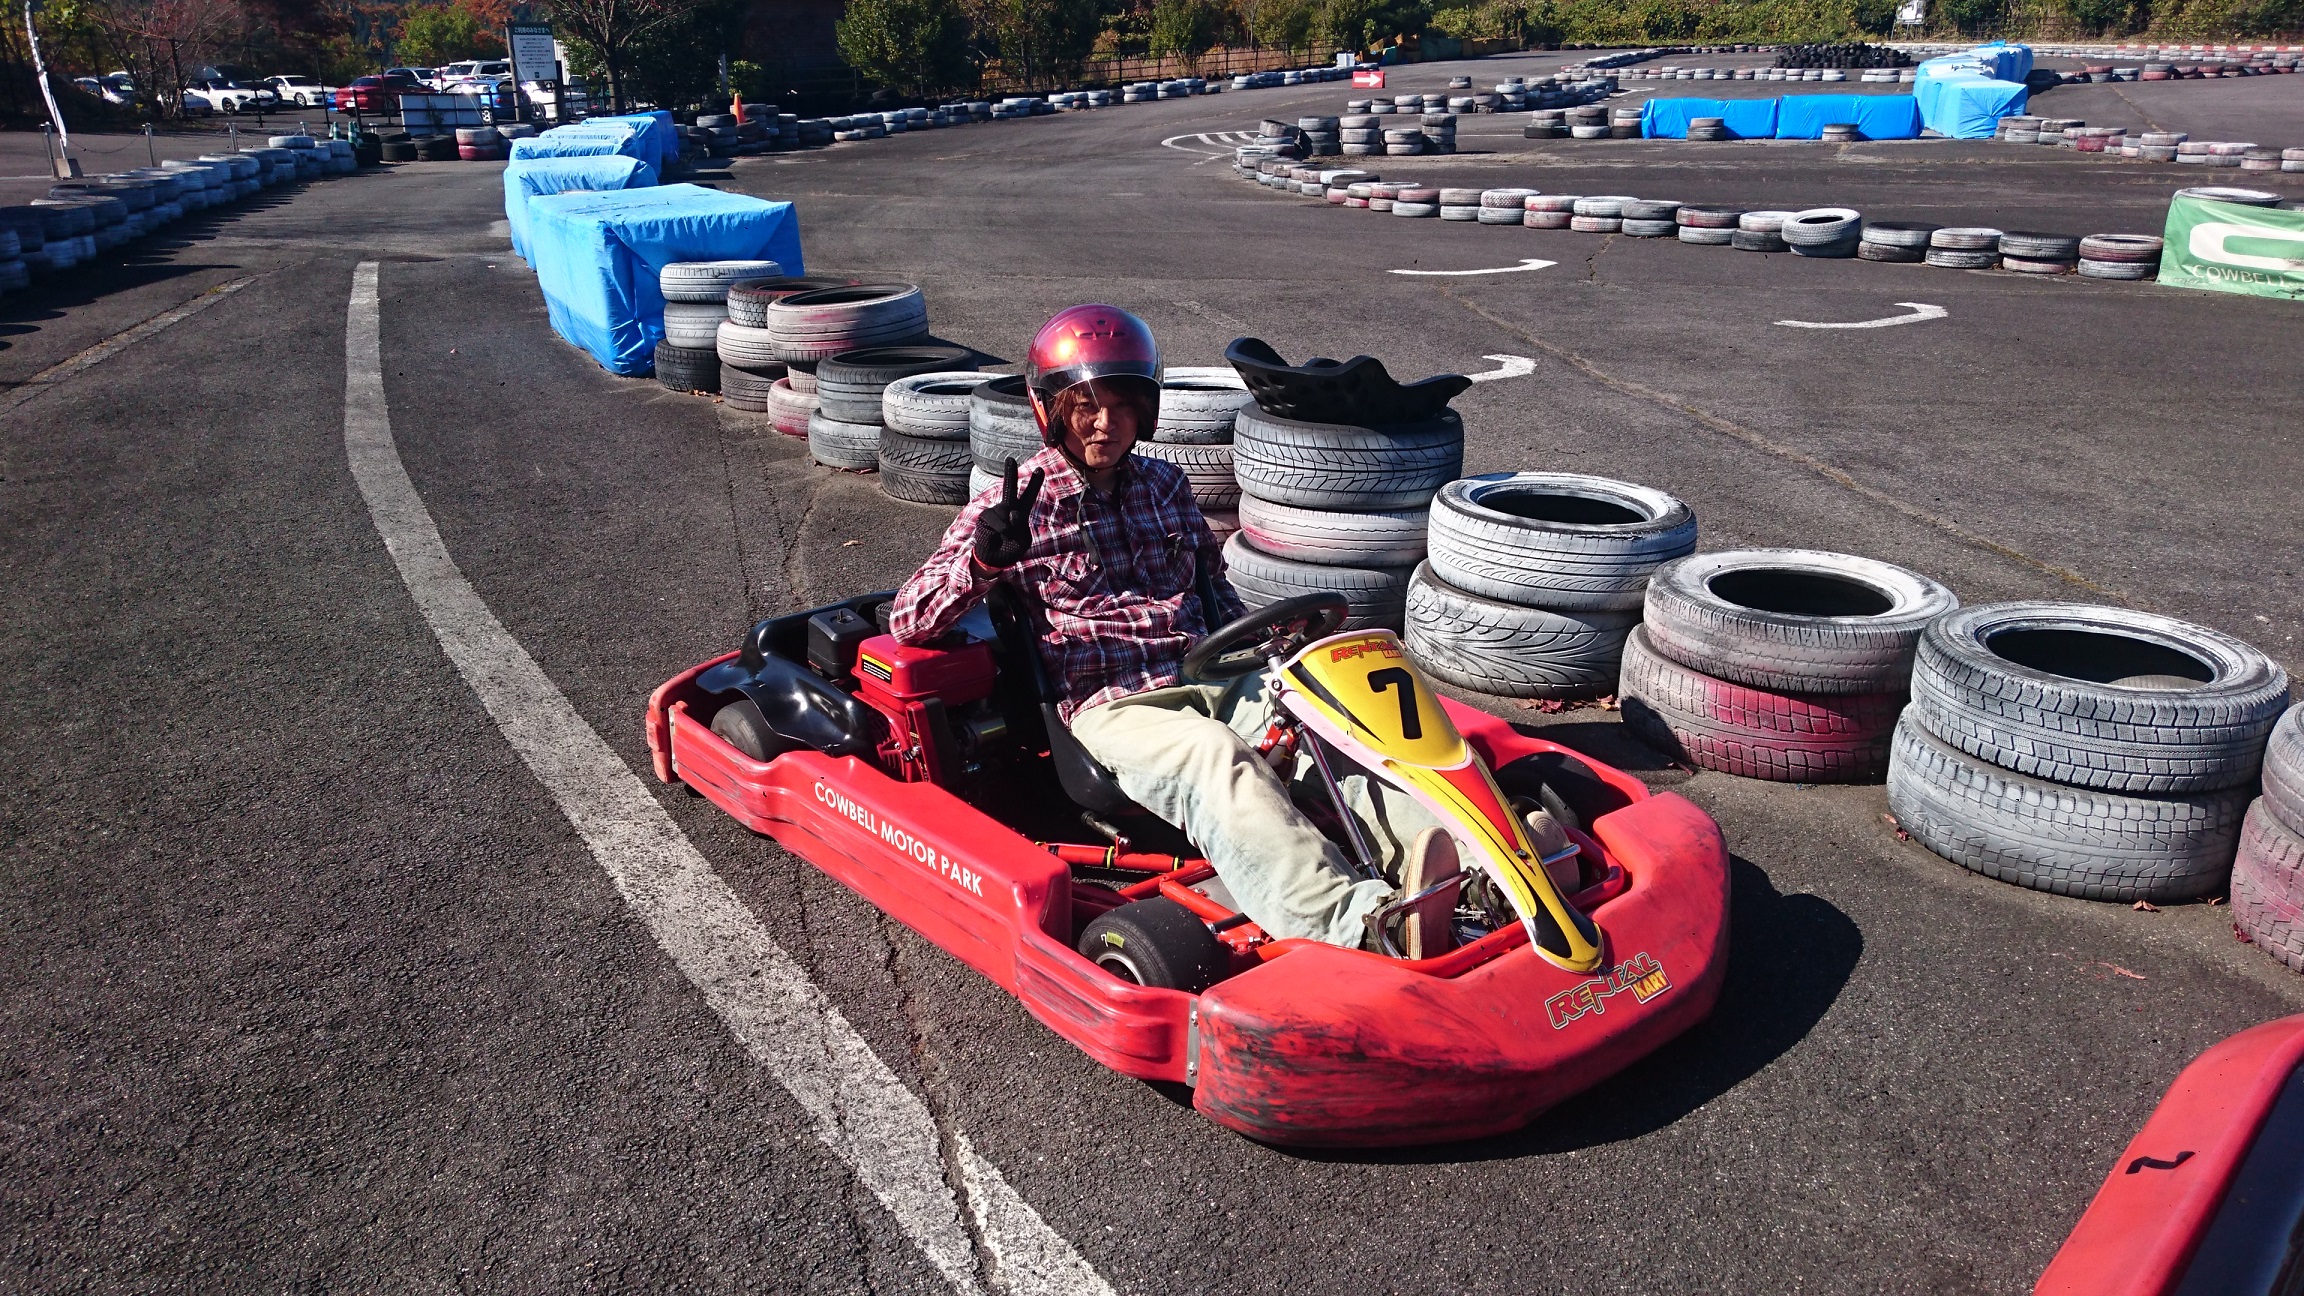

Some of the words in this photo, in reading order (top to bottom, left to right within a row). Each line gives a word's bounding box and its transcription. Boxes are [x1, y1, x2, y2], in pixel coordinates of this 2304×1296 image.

[1331, 639, 1398, 663] RENTAL
[1383, 649, 1403, 659] KART
[1367, 666, 1423, 740] 7
[814, 782, 877, 835] COWBELL
[880, 820, 937, 871] MOTOR
[941, 854, 984, 898] PARK
[1546, 952, 1661, 1029] RENTAL
[1631, 969, 1669, 1001] KART
